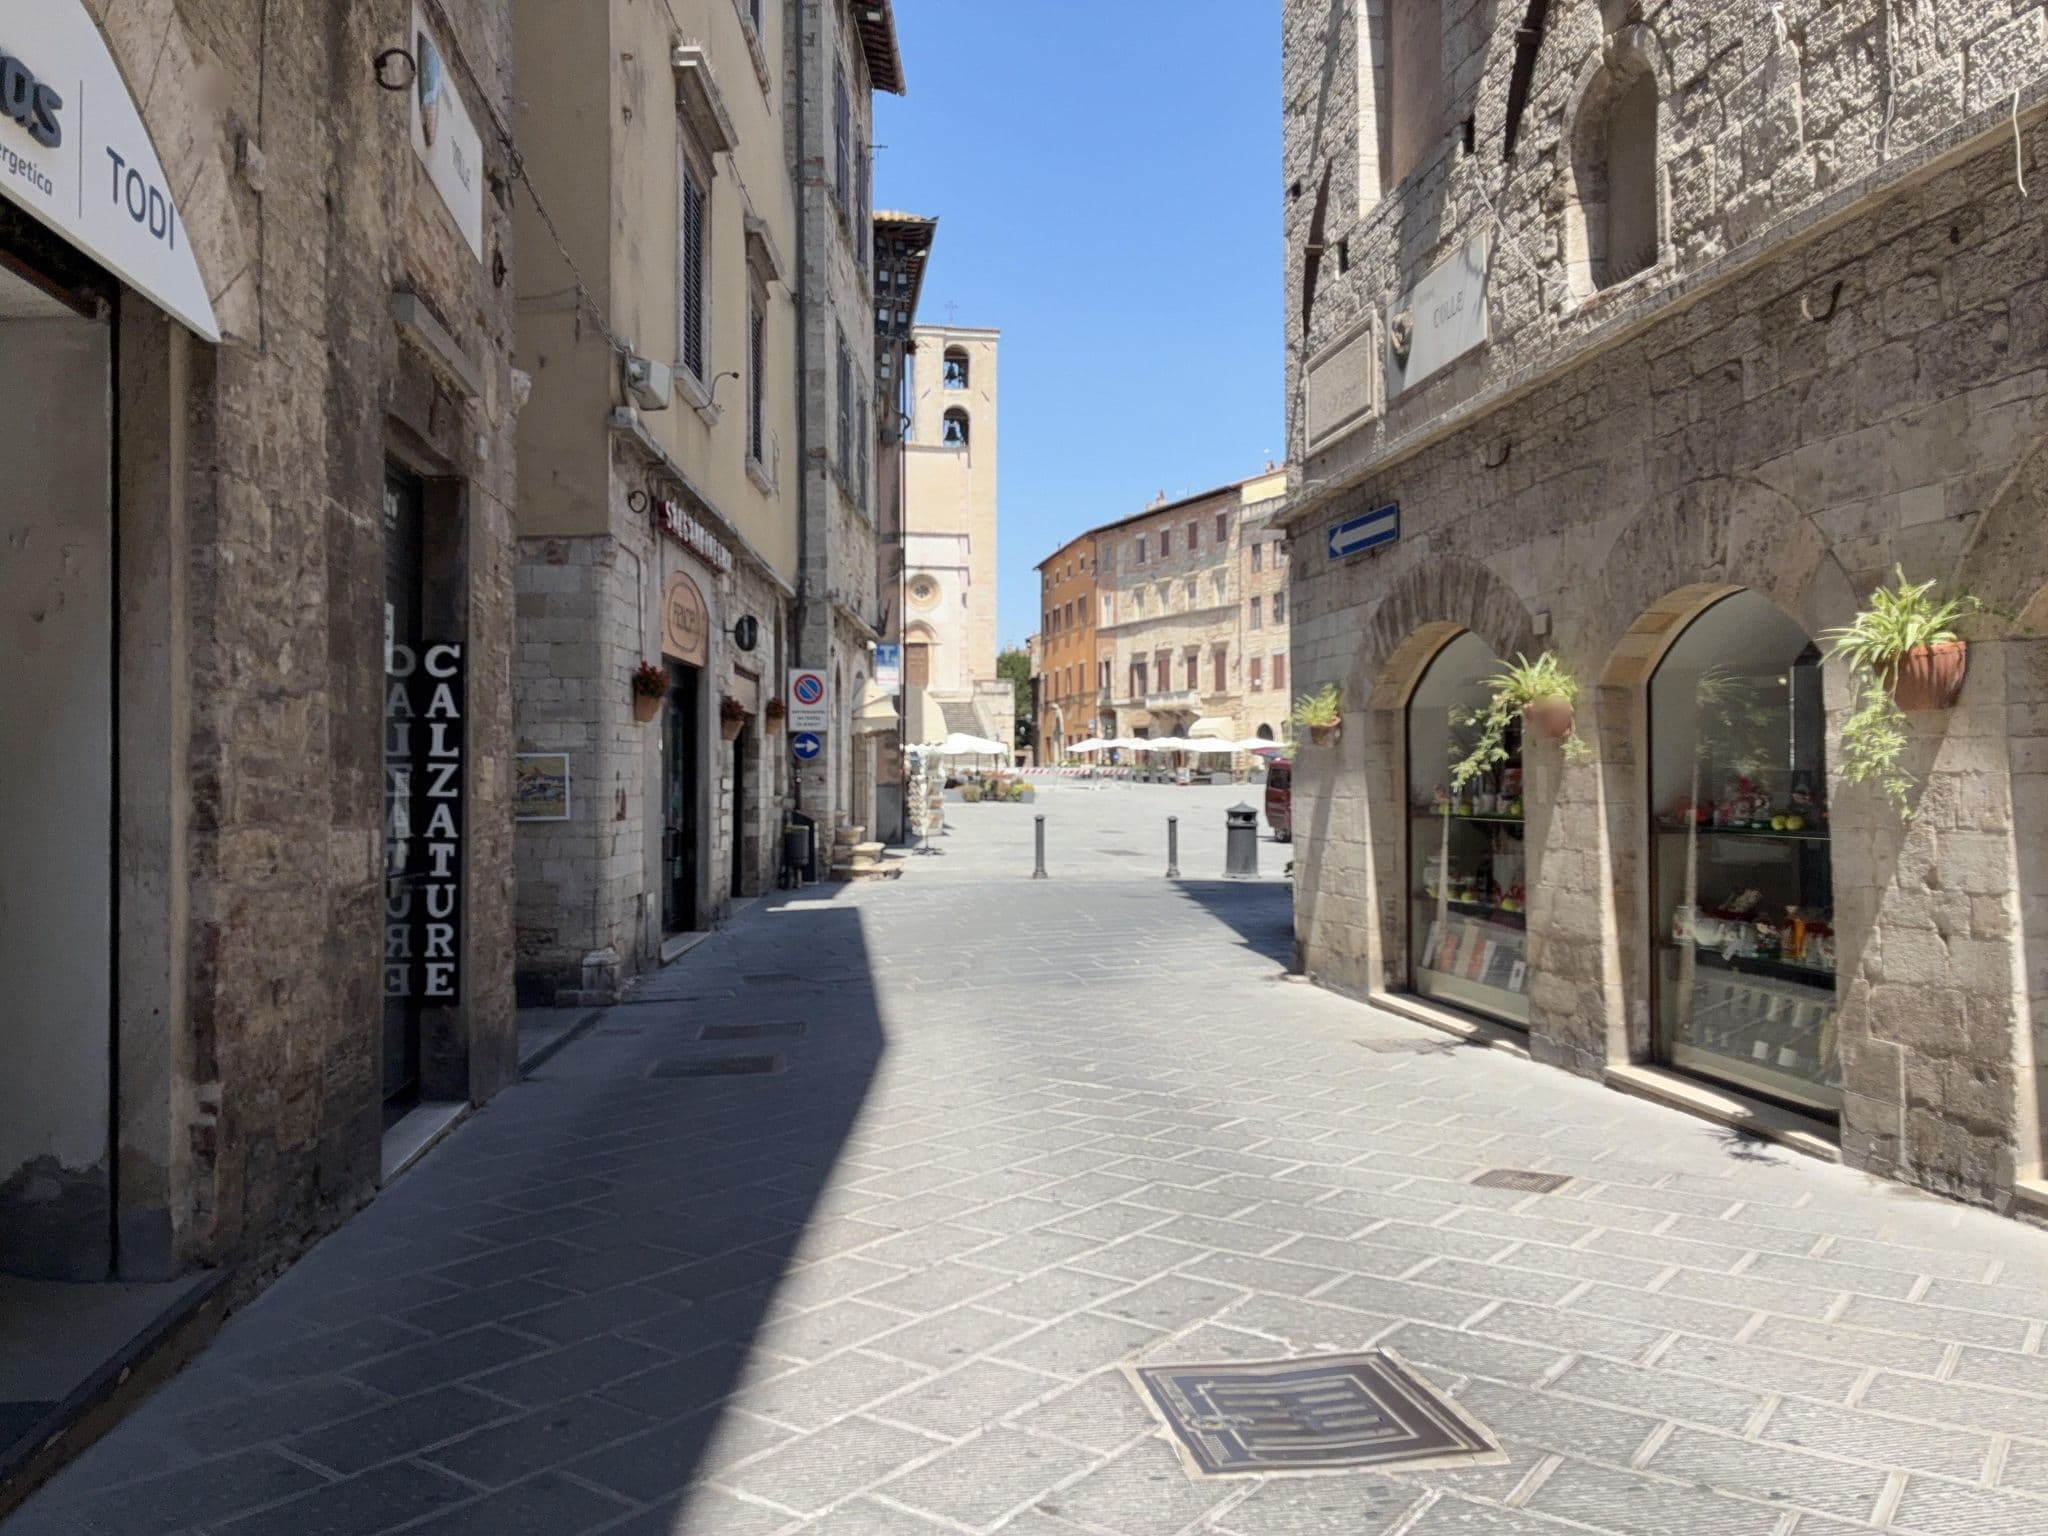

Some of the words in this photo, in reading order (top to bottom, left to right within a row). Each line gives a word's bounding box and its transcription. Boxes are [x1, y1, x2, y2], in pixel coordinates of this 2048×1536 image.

[0, 143, 53, 197] rgetica
[105, 145, 175, 251] TODI
[423, 643, 461, 997] CALZATURE
